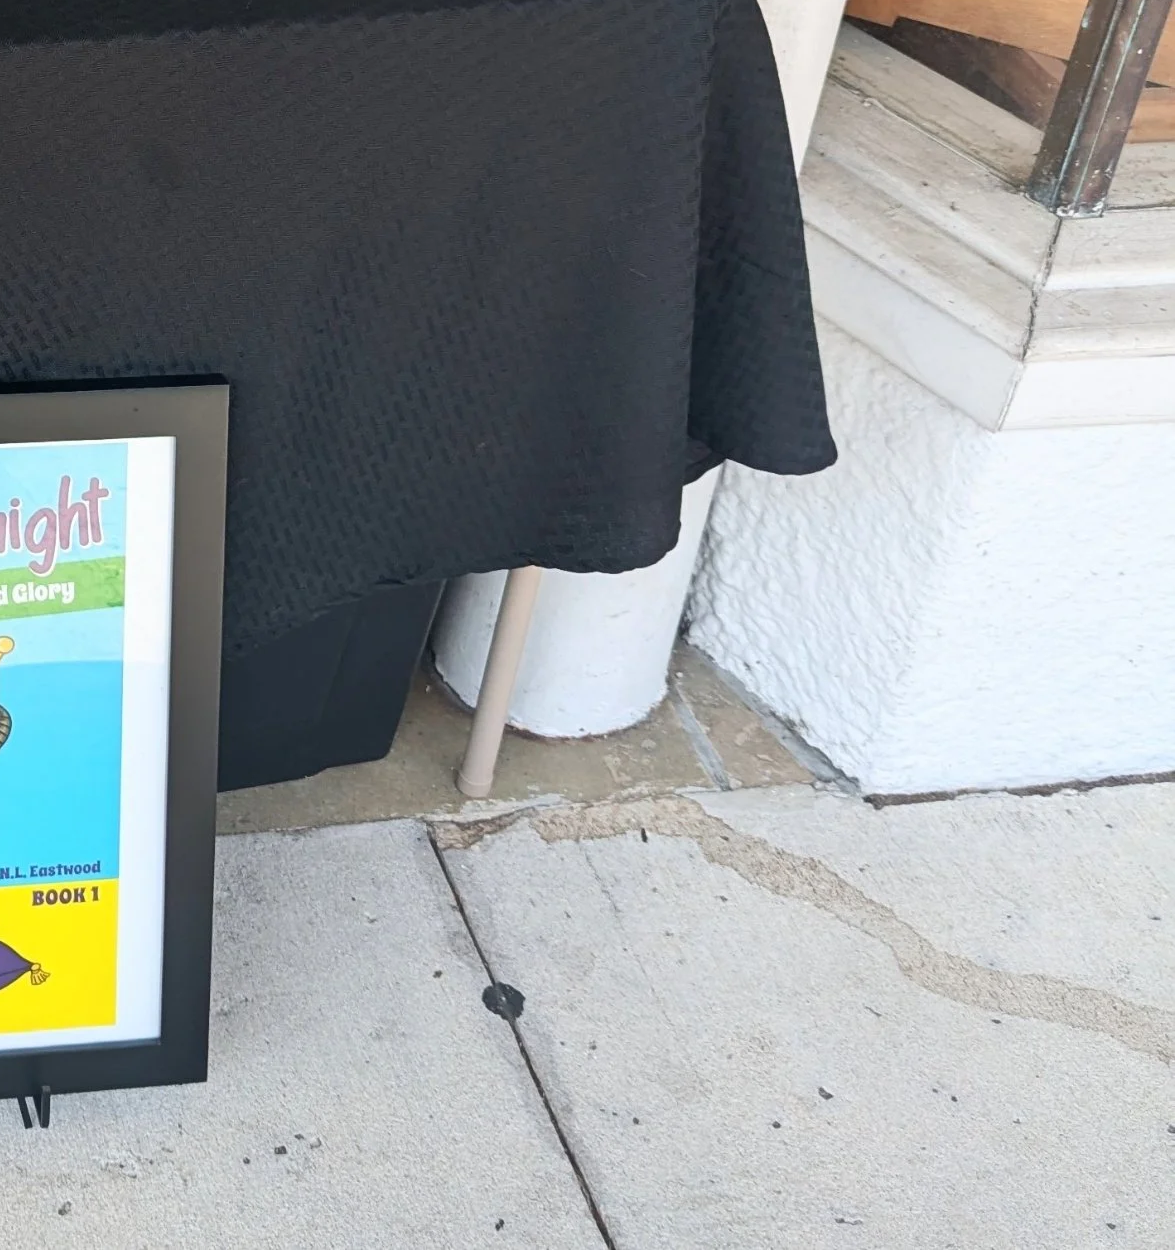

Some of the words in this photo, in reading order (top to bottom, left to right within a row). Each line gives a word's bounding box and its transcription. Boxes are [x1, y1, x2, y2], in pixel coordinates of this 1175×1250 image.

[11, 579, 75, 605] Glory
[0, 866, 27, 880] N.L.
[29, 860, 101, 878] Eastwood
[31, 887, 87, 906] BOOK
[91, 886, 99, 901] 1
